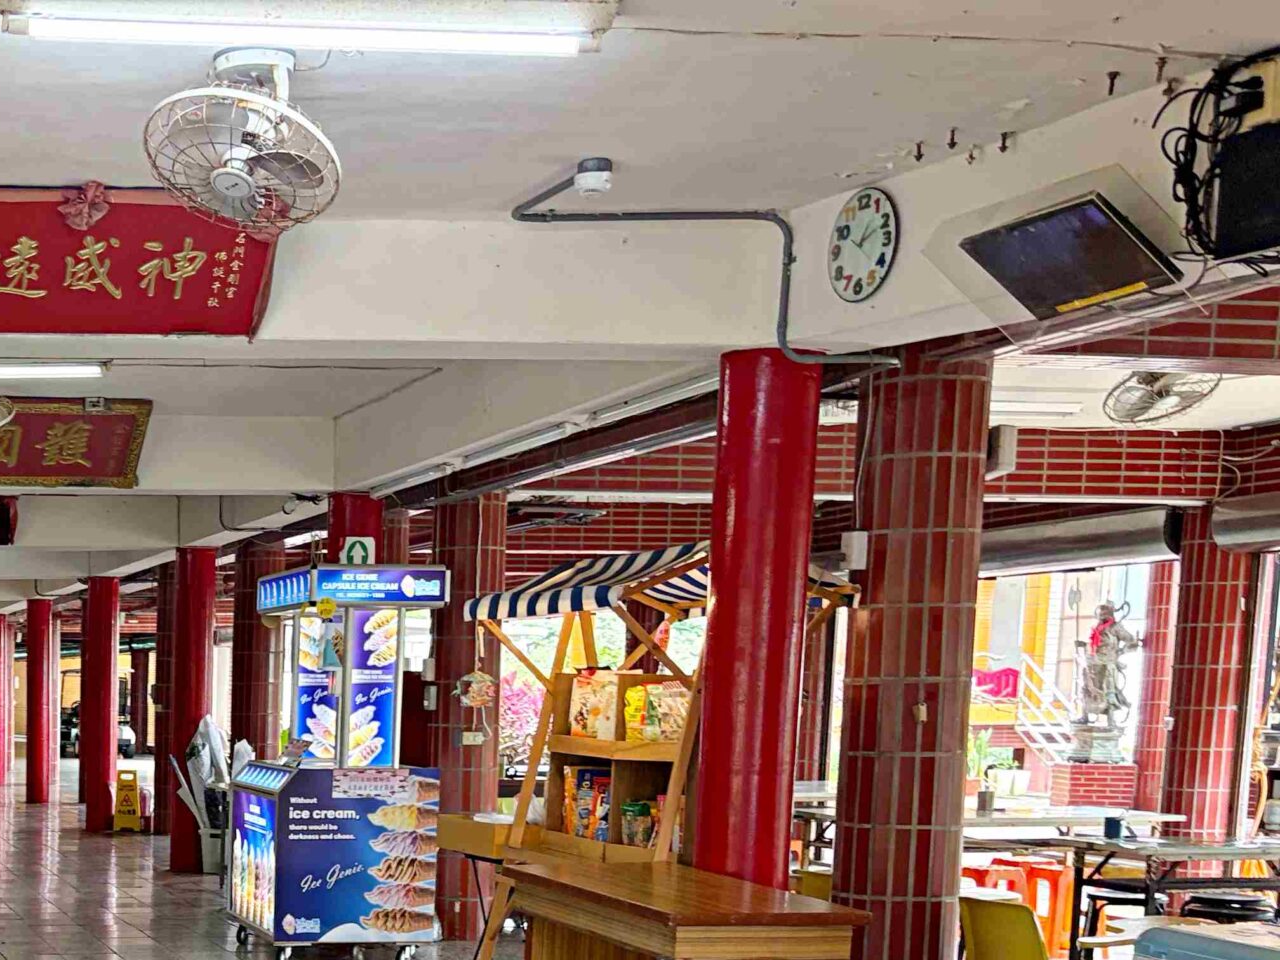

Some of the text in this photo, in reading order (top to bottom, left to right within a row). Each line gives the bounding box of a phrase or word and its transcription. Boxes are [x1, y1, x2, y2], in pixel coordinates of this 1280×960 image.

[857, 193, 872, 211] 12
[874, 197, 881, 214] 1
[880, 212, 890, 229] 2
[836, 224, 851, 242] 10
[881, 230, 892, 247] 3
[831, 244, 841, 262] 9
[875, 252, 886, 268] 4
[834, 265, 844, 282] 8
[866, 269, 877, 287] 5
[843, 274, 853, 292] 7
[853, 277, 863, 295] 6
[289, 807, 360, 820] ice cream,
